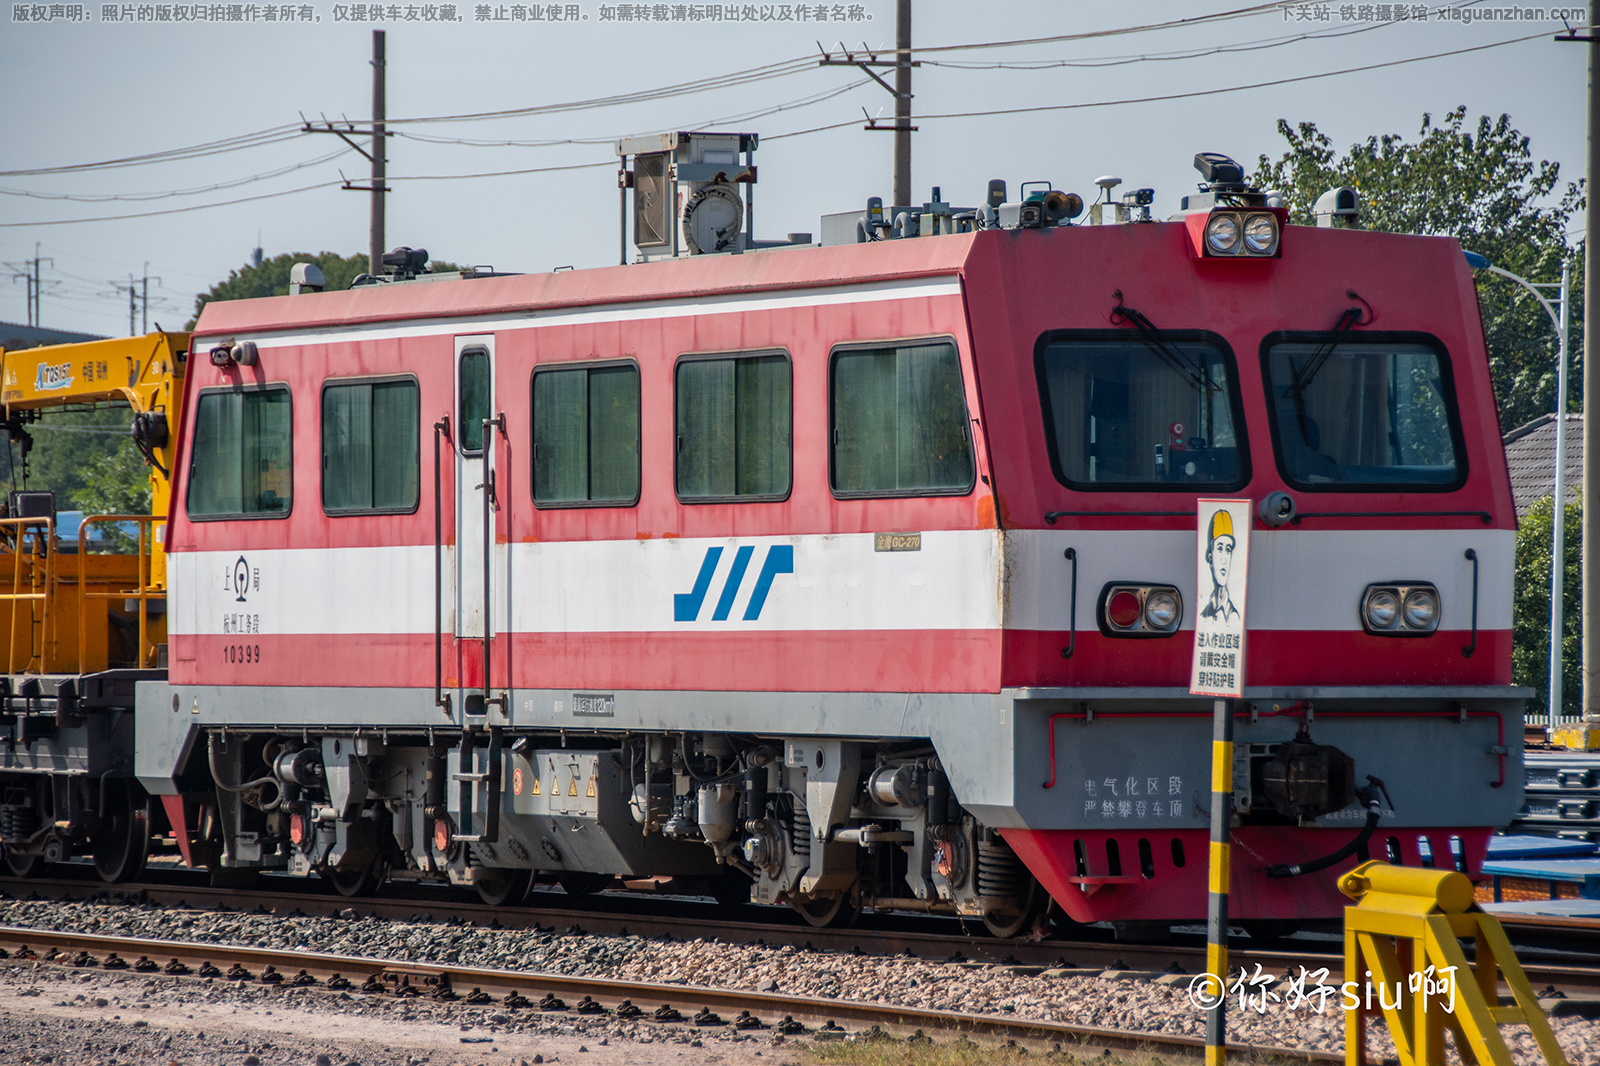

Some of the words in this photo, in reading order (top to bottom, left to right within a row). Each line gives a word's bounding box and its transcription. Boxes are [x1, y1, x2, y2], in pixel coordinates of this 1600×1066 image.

[223, 566, 230, 591] 上
[253, 567, 260, 592] 局
[223, 613, 260, 634] 杭州工务段
[1197, 632, 1240, 649] 进入作业区域
[223, 644, 260, 664] 10399
[1199, 652, 1236, 669] 请戴安全帽
[1084, 776, 1182, 796] 电气化区段
[1084, 799, 1182, 819] 严禁攀登车顶
